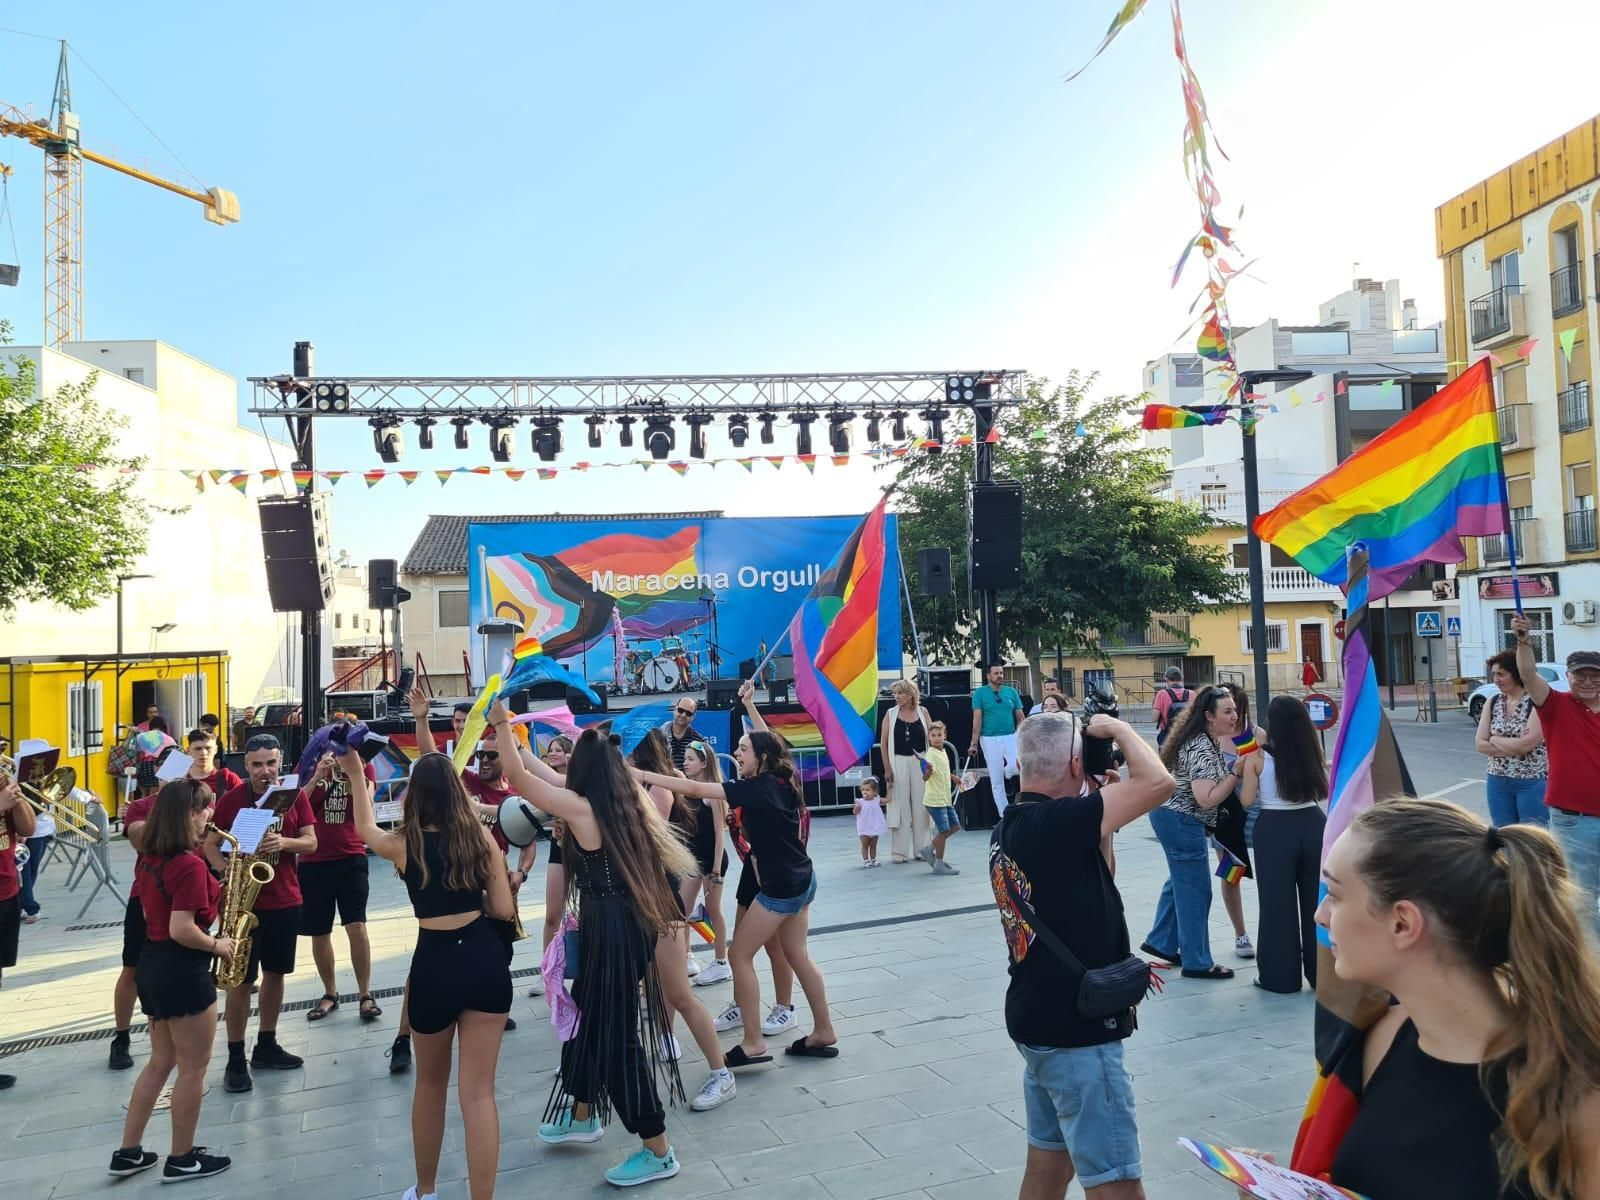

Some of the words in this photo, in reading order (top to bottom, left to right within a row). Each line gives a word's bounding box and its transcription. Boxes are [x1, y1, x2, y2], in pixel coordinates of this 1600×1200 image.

[591, 570, 729, 593] Maracena
[737, 564, 821, 593] Orgull
[324, 798, 348, 811] LARGO
[325, 811, 346, 825] BAND
